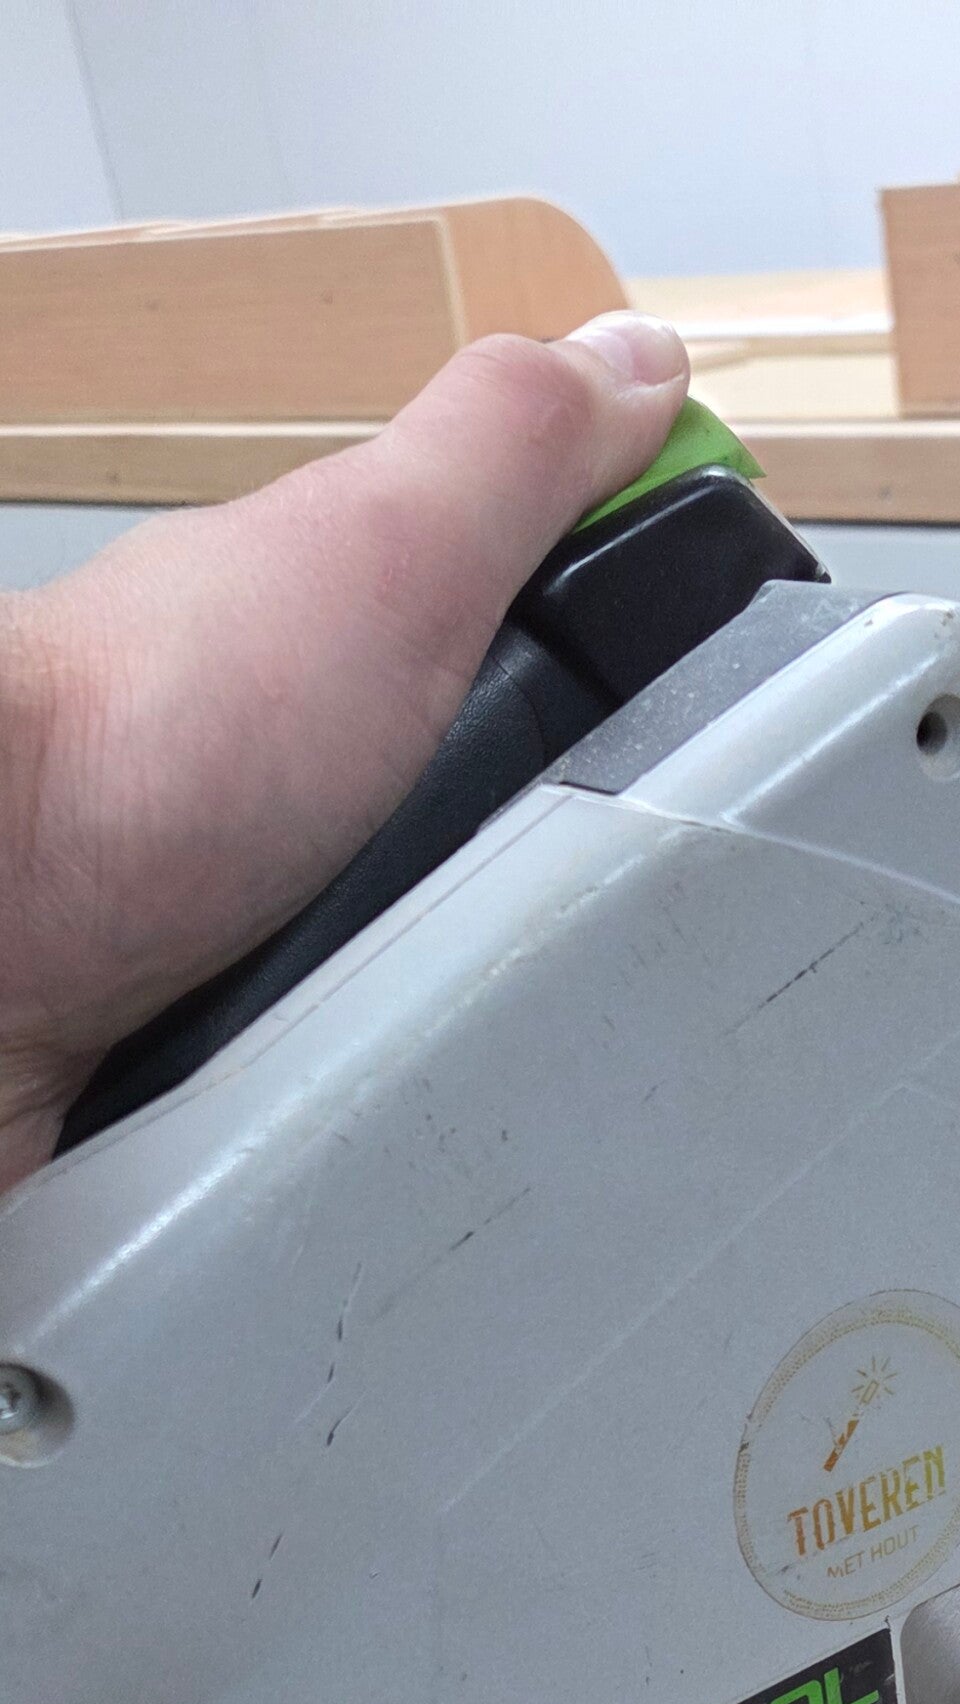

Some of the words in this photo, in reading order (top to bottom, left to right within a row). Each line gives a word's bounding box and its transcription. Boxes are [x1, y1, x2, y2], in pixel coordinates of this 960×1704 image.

[786, 1445, 947, 1556] TOVEREN
[826, 1551, 865, 1578] MET
[870, 1524, 919, 1565] HOUT
